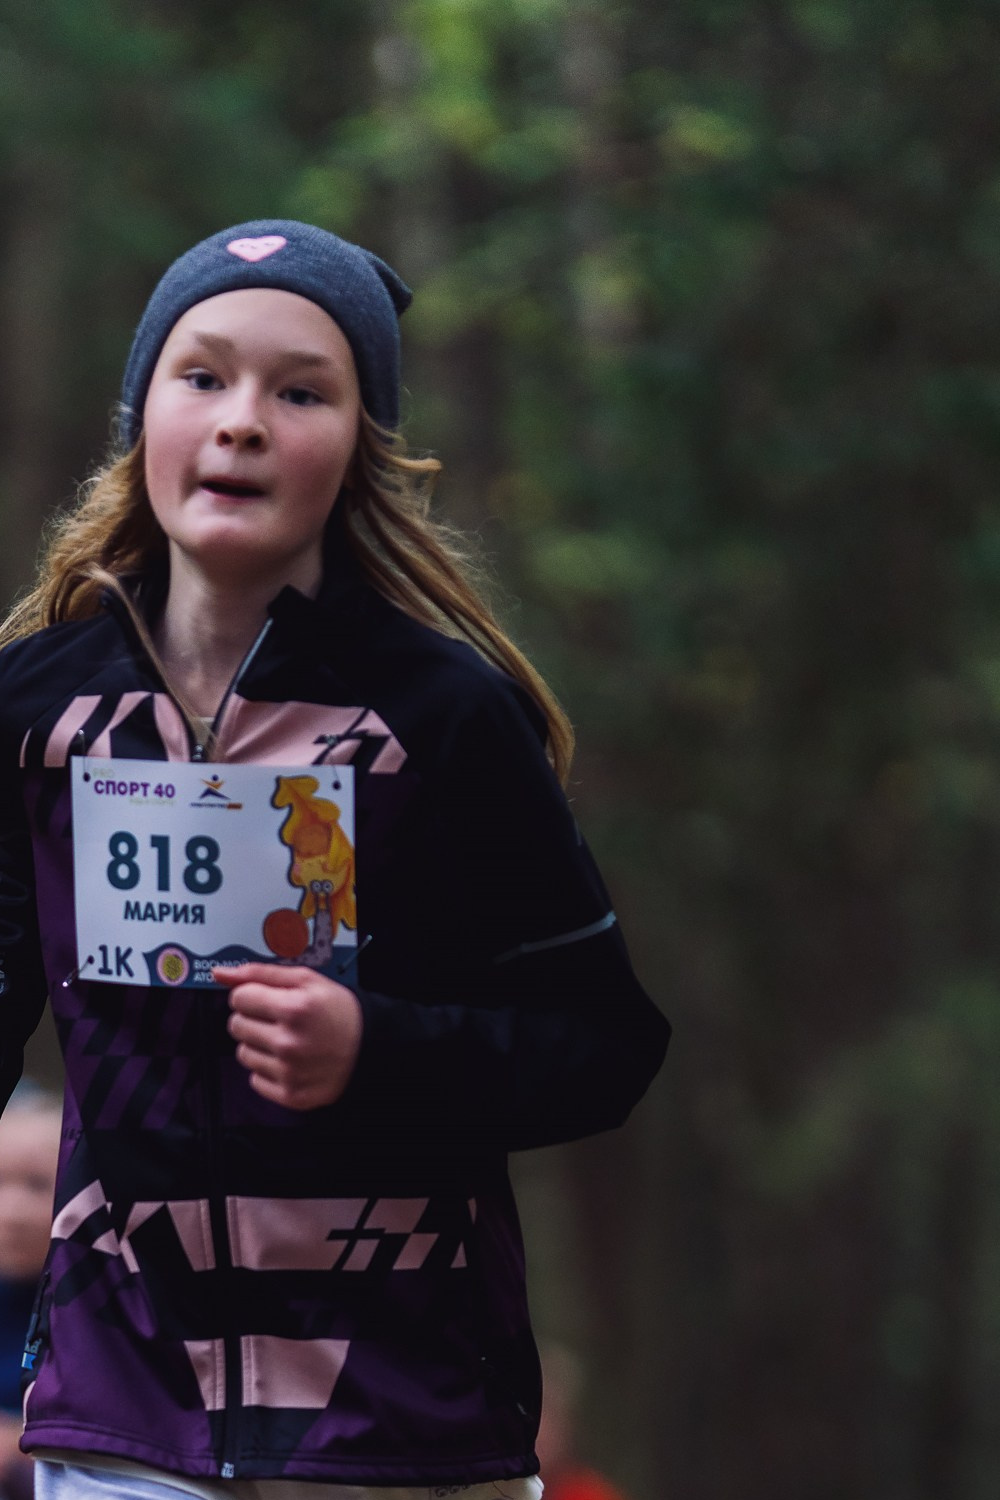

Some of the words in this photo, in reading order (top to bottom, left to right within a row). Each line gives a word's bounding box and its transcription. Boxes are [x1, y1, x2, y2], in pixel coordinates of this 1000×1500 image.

[94, 779, 150, 798] СПОРТ
[153, 782, 176, 798] 40
[106, 830, 223, 895] 818
[123, 901, 205, 924] МАРИЯ
[193, 971, 216, 984] АТО
